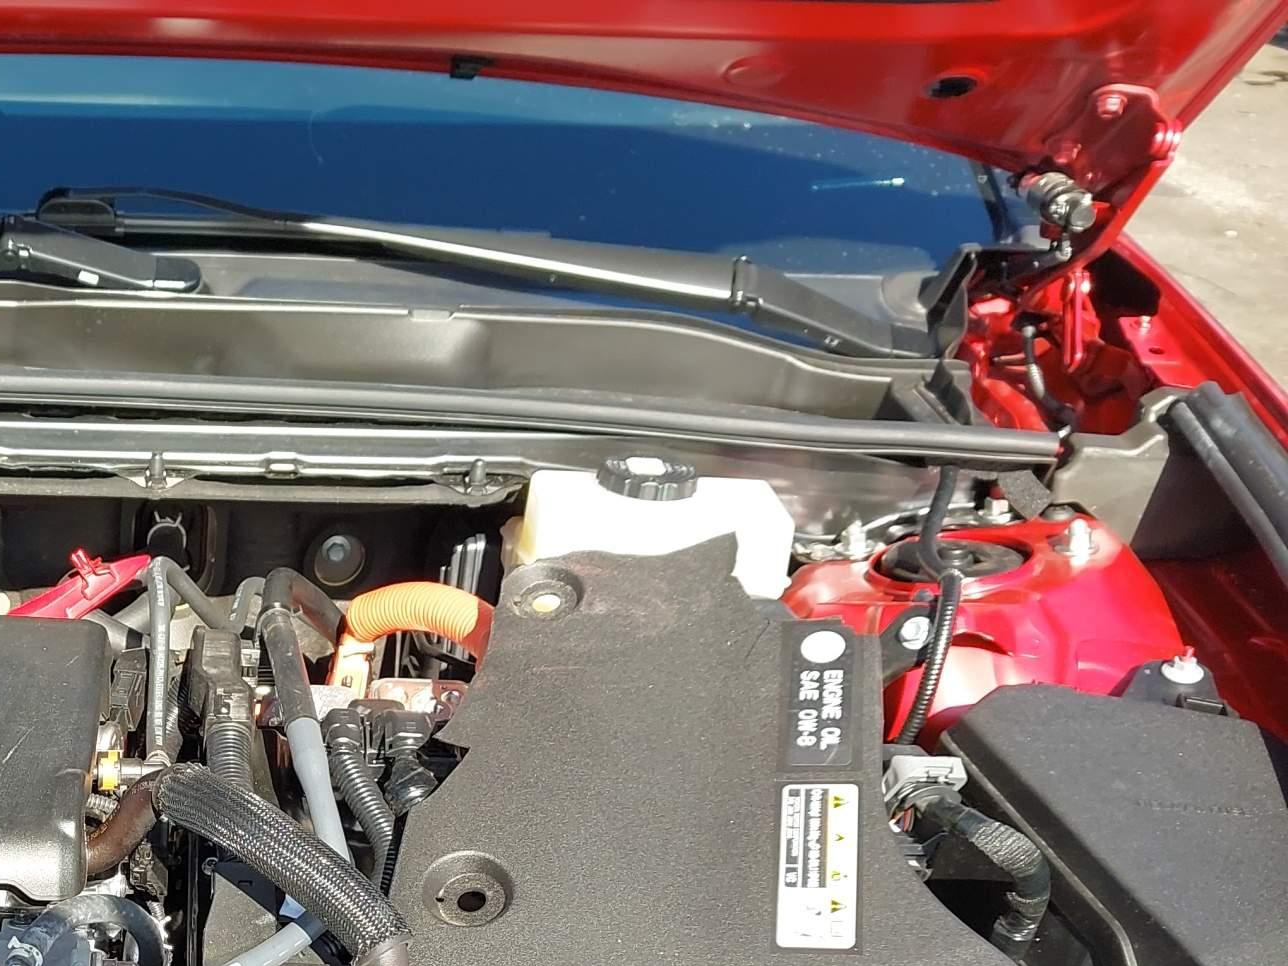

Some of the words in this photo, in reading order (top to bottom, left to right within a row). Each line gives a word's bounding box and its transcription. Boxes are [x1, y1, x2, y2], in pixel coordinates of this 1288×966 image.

[799, 670, 821, 701] SAE
[821, 670, 844, 720] ENGINE
[819, 727, 841, 751] OIL
